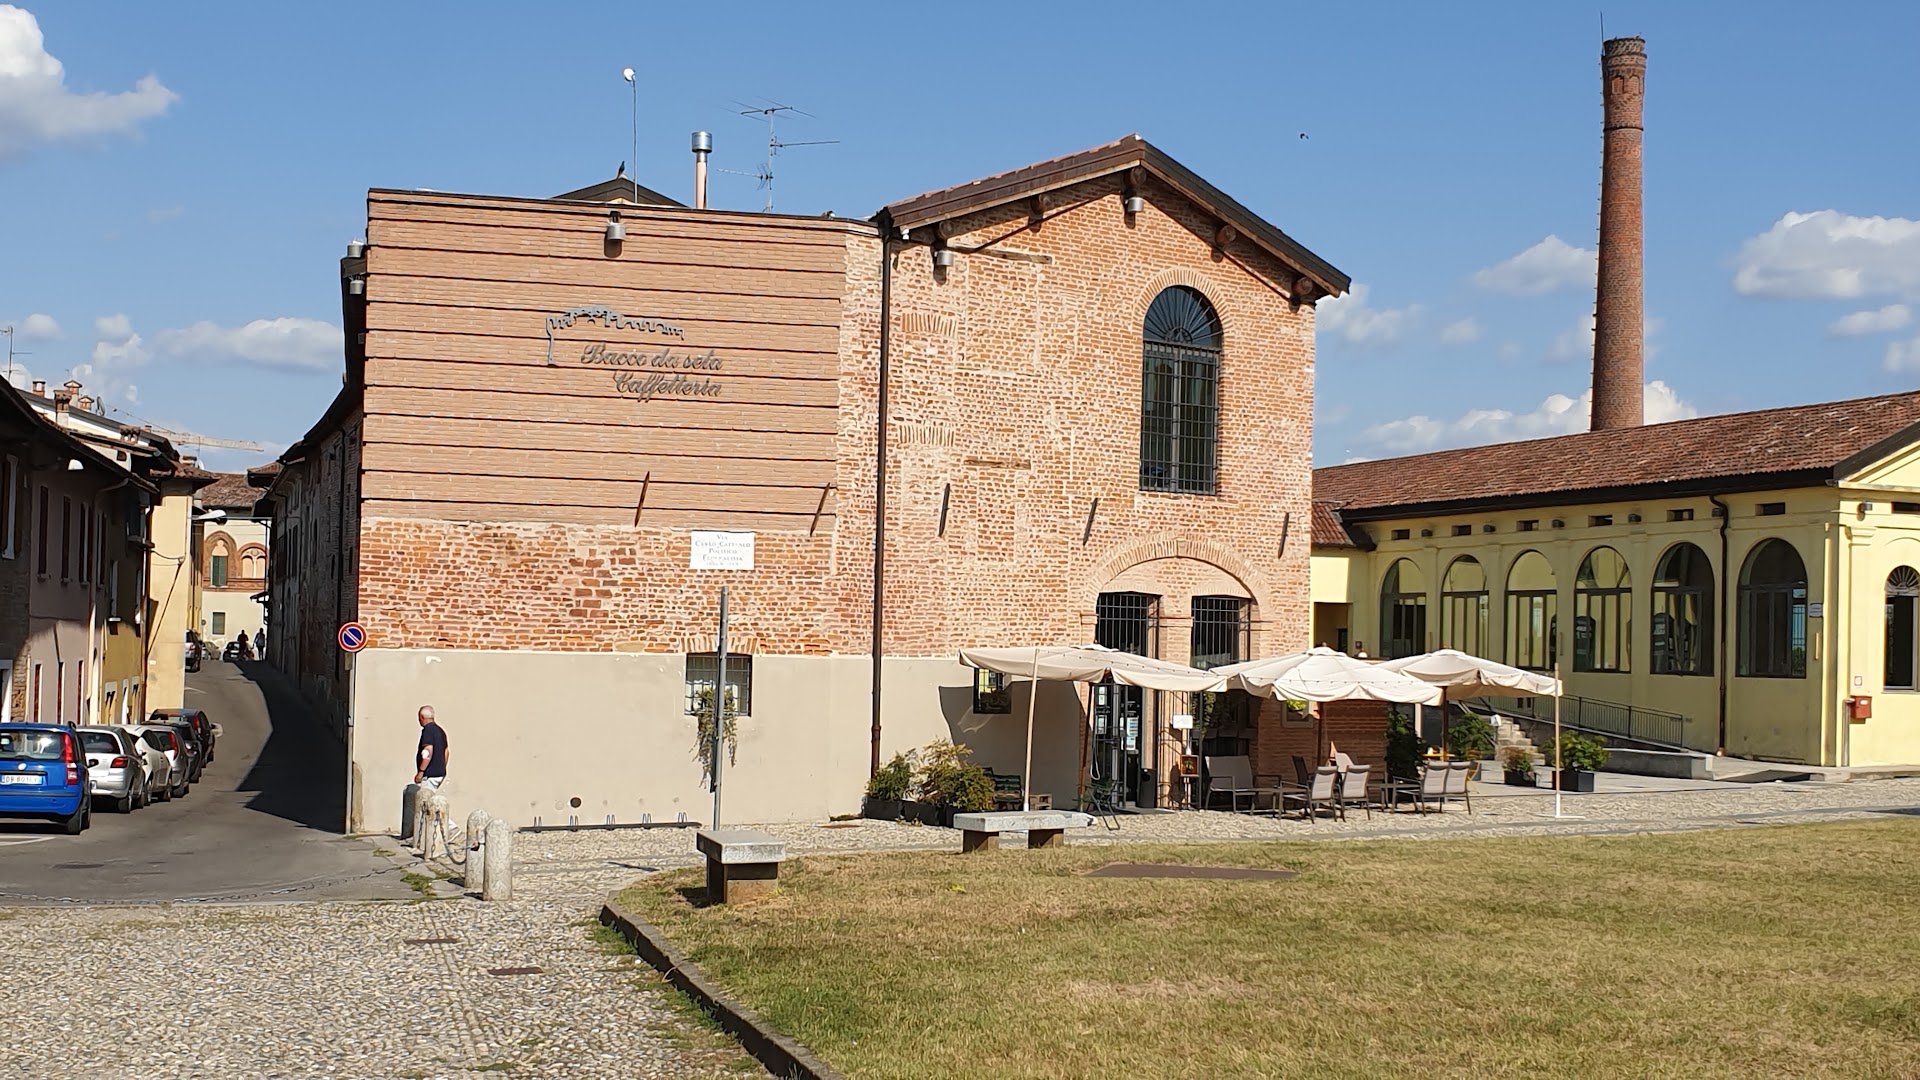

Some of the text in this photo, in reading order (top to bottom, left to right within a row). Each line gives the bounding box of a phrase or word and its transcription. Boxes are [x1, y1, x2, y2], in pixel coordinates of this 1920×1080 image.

[581, 343, 722, 371] Bacco da seta
[613, 370, 722, 403] Caffetteria
